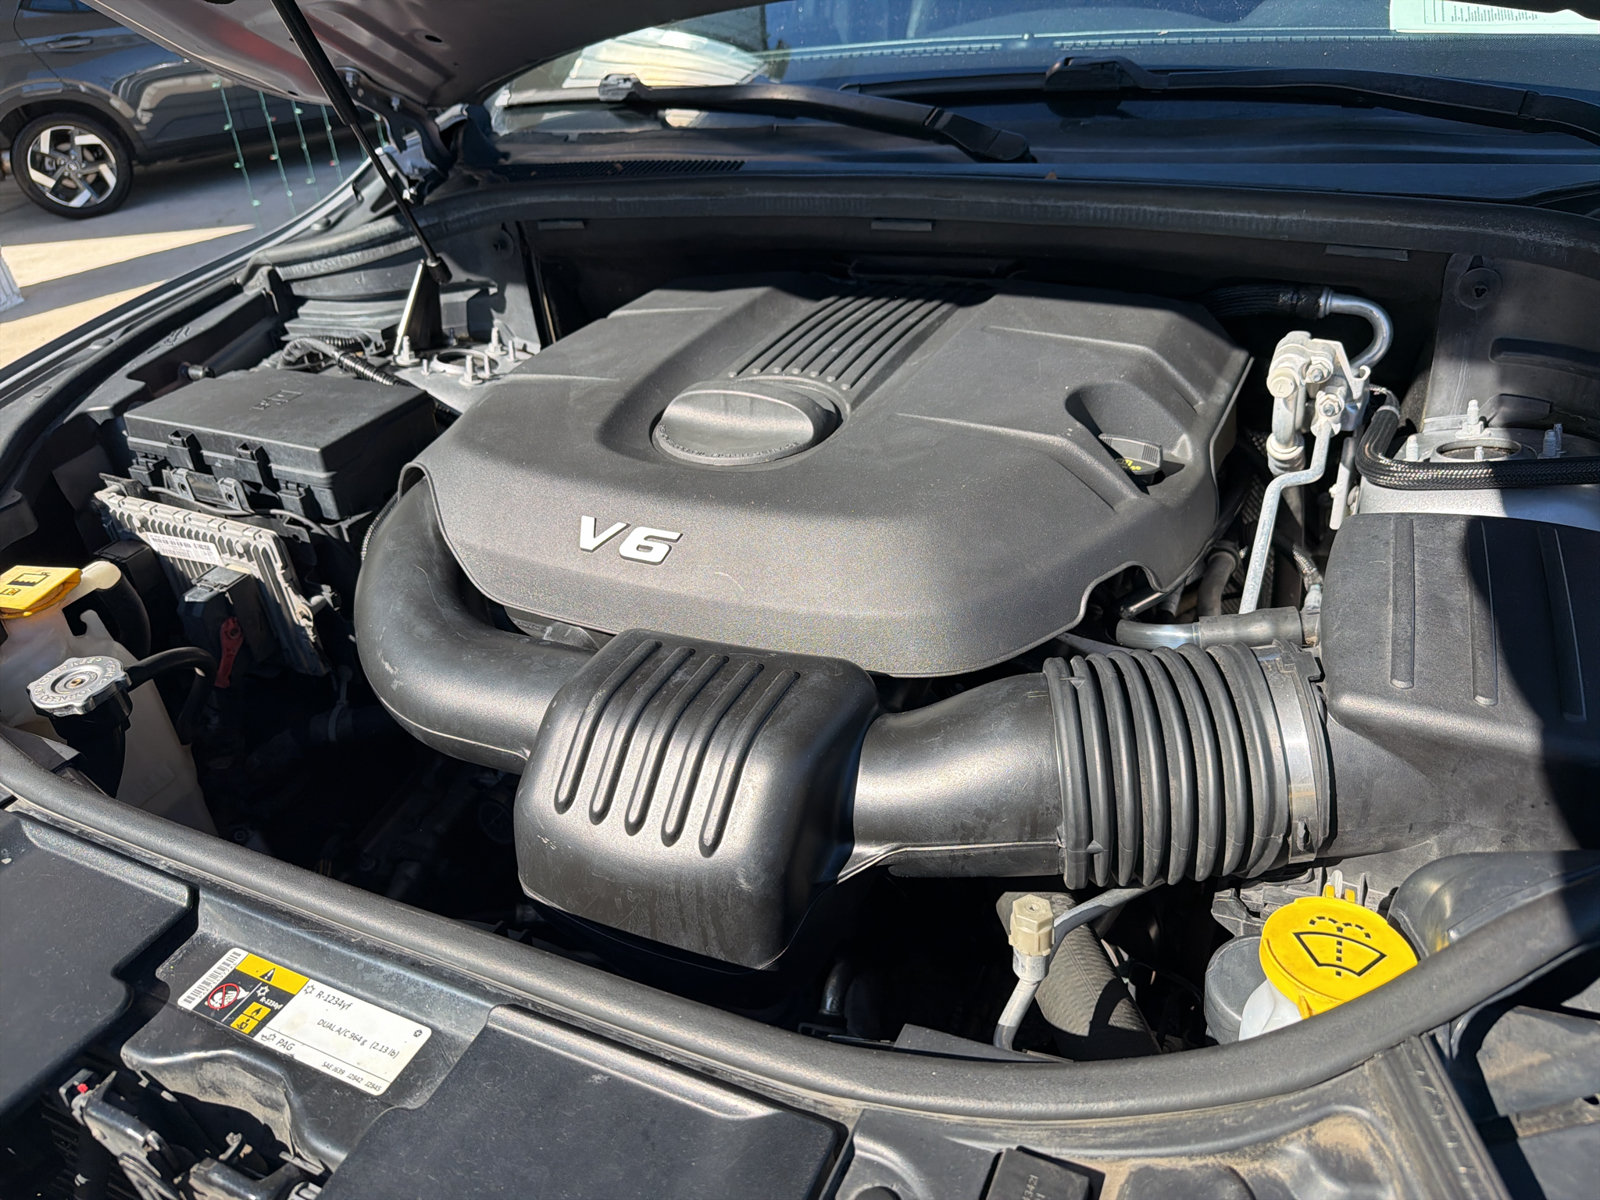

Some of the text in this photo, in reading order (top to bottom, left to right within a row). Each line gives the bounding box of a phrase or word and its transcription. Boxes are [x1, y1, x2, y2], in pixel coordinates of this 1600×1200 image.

[580, 515, 683, 565] V6
[316, 990, 352, 1011] R-1234yf
[276, 1038, 296, 1052] PAG
[317, 1019, 335, 1032] DUAL
[335, 1027, 350, 1038] A/C
[349, 1032, 363, 1043] 964
[369, 1040, 390, 1054] (2.13
[388, 1049, 400, 1059] lb)
[322, 1061, 333, 1070] SAE
